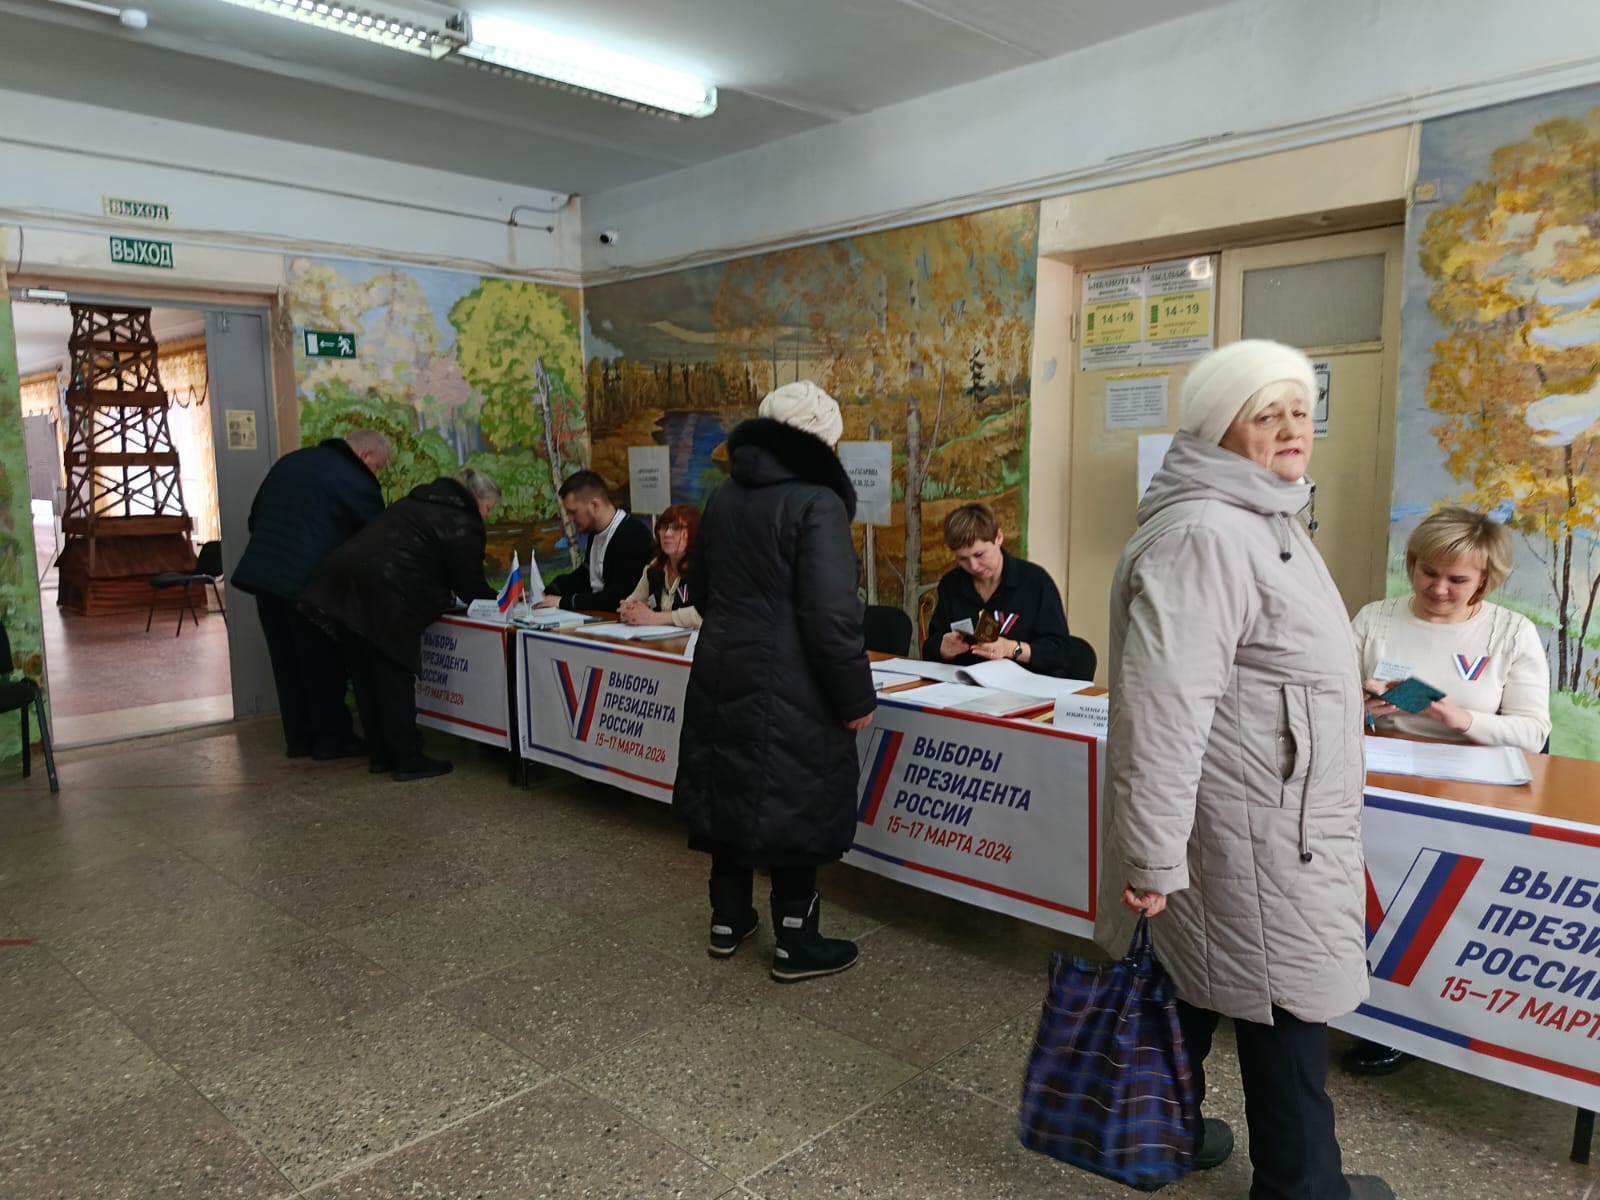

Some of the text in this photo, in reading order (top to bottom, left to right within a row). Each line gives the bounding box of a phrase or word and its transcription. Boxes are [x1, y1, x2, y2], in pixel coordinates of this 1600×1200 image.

[110, 200, 168, 220] ВЫХОД
[111, 238, 172, 267] ВЫХОД
[608, 671, 660, 697] ВЫБОРЫ
[603, 691, 677, 724] ПРЕЗИДЕНТА
[598, 713, 645, 739] РОССИИ
[617, 738, 645, 759] МАРТА
[644, 745, 667, 764] 2024
[912, 736, 1003, 774] ВЫБОРЫ
[903, 763, 1031, 812] ПРЕЗИДЕНТА
[893, 789, 973, 827] РОССИИ
[923, 825, 973, 854] МАРТА
[974, 838, 1013, 864] 2024
[1518, 996, 1600, 1042] МАРТ
